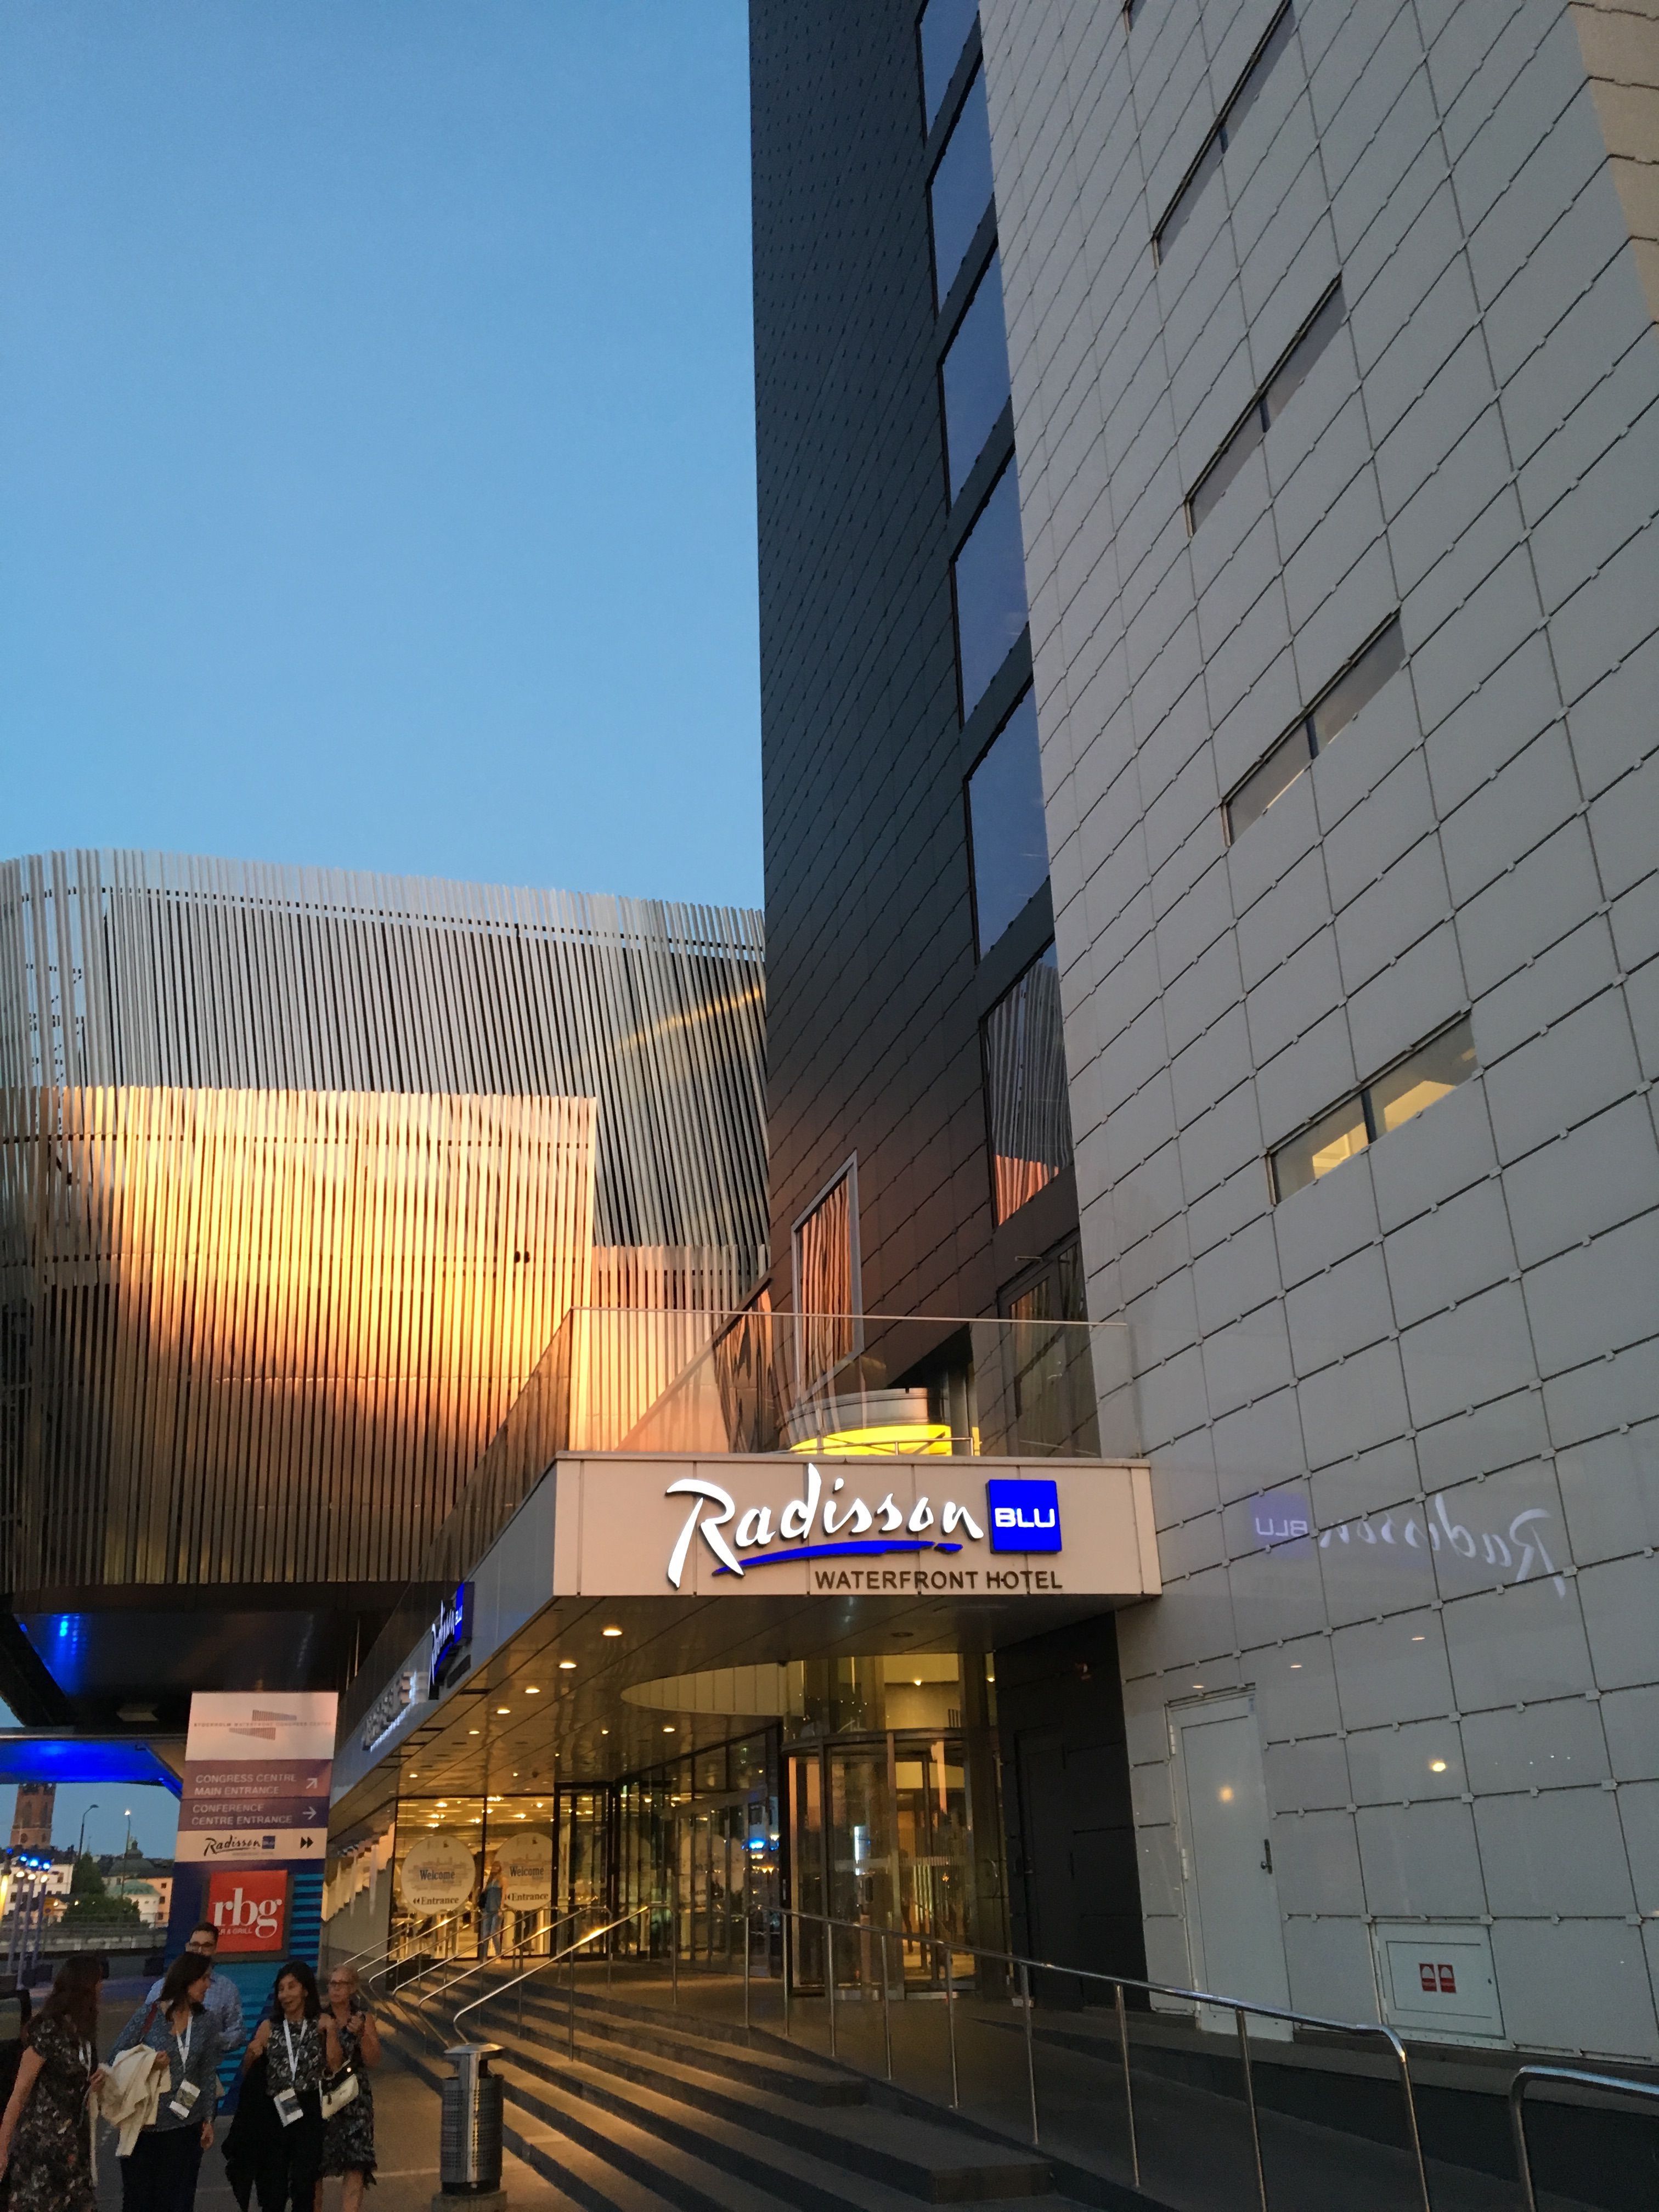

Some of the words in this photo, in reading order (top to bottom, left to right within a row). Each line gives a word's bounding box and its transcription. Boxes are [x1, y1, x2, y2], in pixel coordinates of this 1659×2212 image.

[665, 1463, 984, 1589] Radisson
[994, 1507, 1055, 1527] BLU
[814, 1570, 979, 1589] WATERFRONT
[987, 1570, 1063, 1590] HOTEL
[196, 1774, 253, 1783] CONGRESS
[256, 1774, 297, 1782] CENTRE
[194, 1787, 222, 1796] MAIN
[224, 1786, 279, 1795] ENTRANCE
[193, 1803, 264, 1813] CONFERENCE
[192, 1816, 234, 1825] CENTRE
[236, 1815, 293, 1825] ENTRANCE
[204, 1835, 261, 1857] Radisson
[420, 1869, 455, 1881] Welcome
[509, 1865, 544, 1877] Welcome
[421, 1897, 459, 1905] Entrance
[511, 1893, 549, 1901] Entrance
[212, 1888, 283, 1938] rbg
